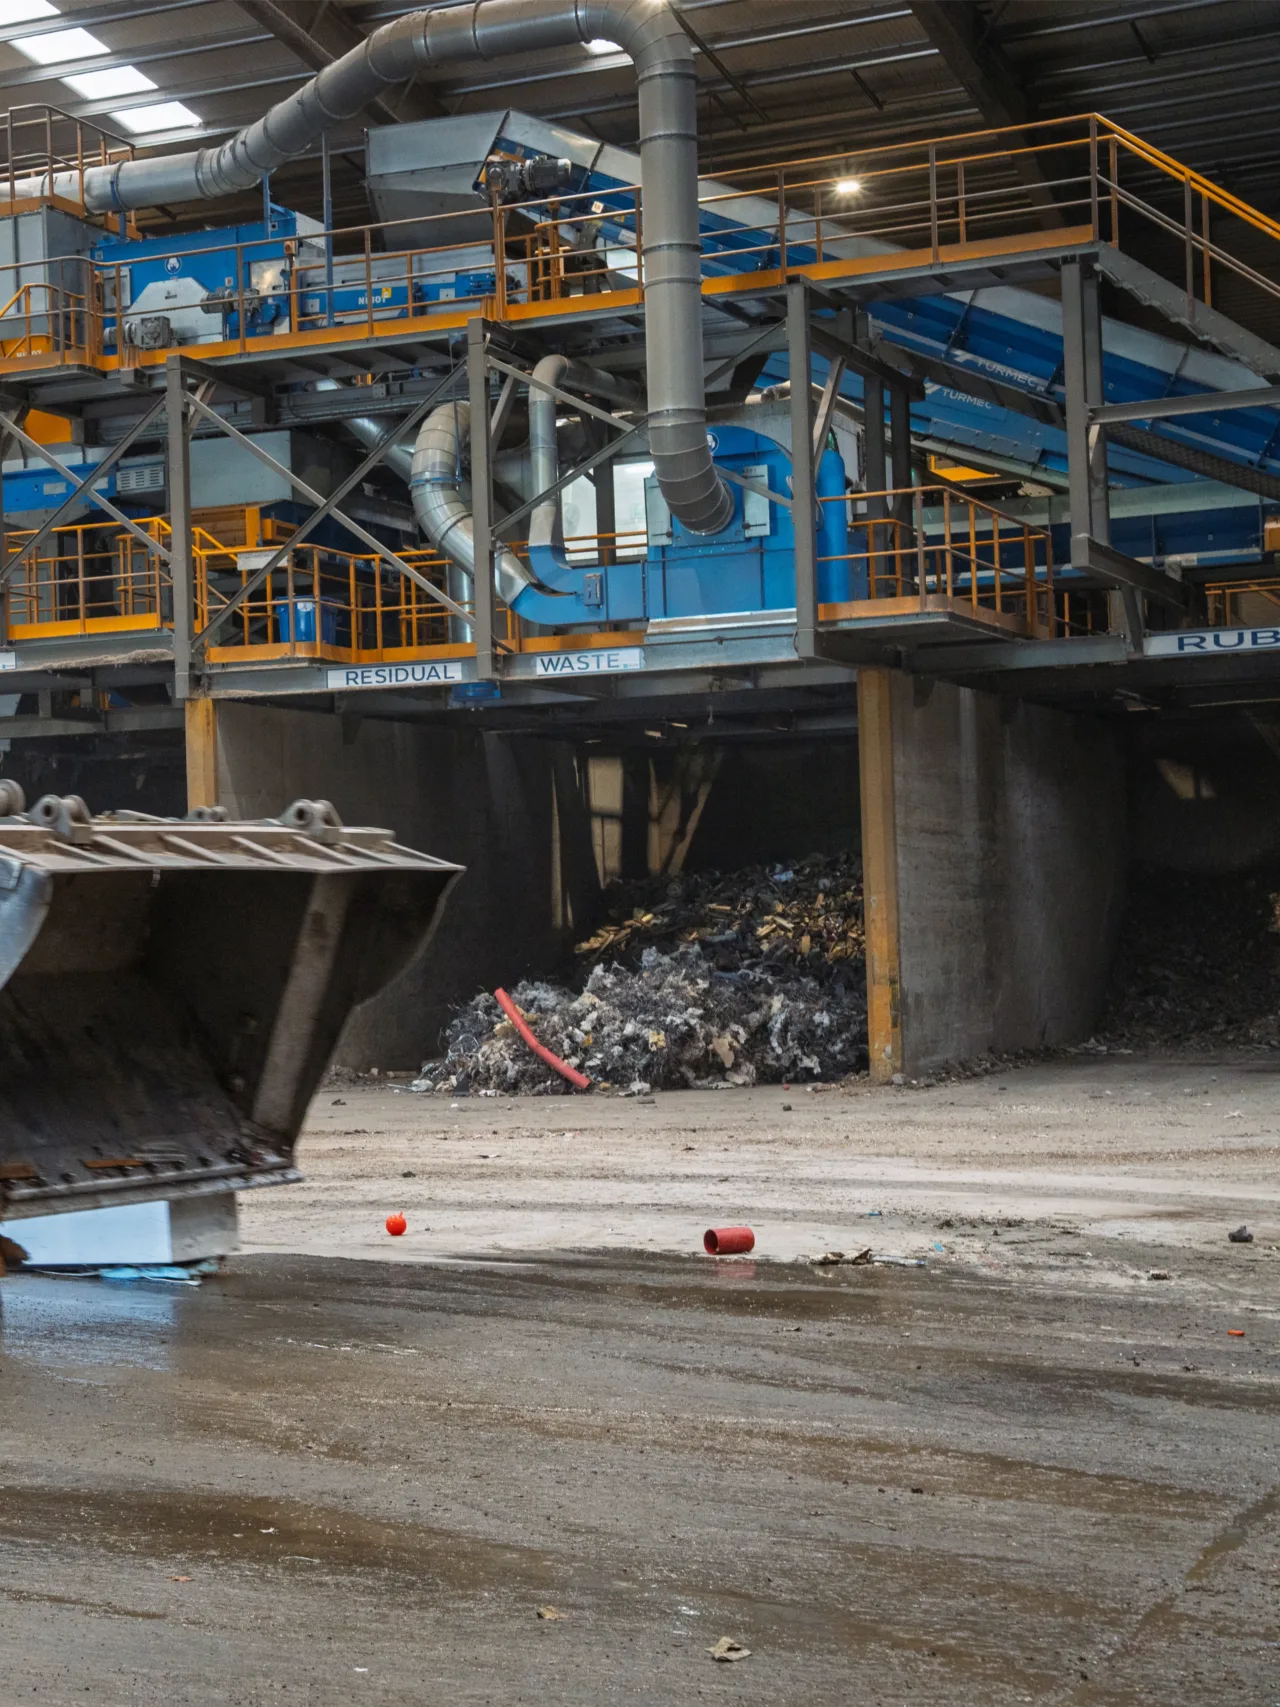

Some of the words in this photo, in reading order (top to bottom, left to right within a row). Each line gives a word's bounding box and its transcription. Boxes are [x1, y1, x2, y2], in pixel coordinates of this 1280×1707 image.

[976, 360, 1037, 387] TURMEC
[942, 388, 993, 409] TURMEC
[1177, 629, 1280, 651] RUB
[540, 653, 620, 673] WASTE
[345, 665, 455, 686] RESIDUAL
